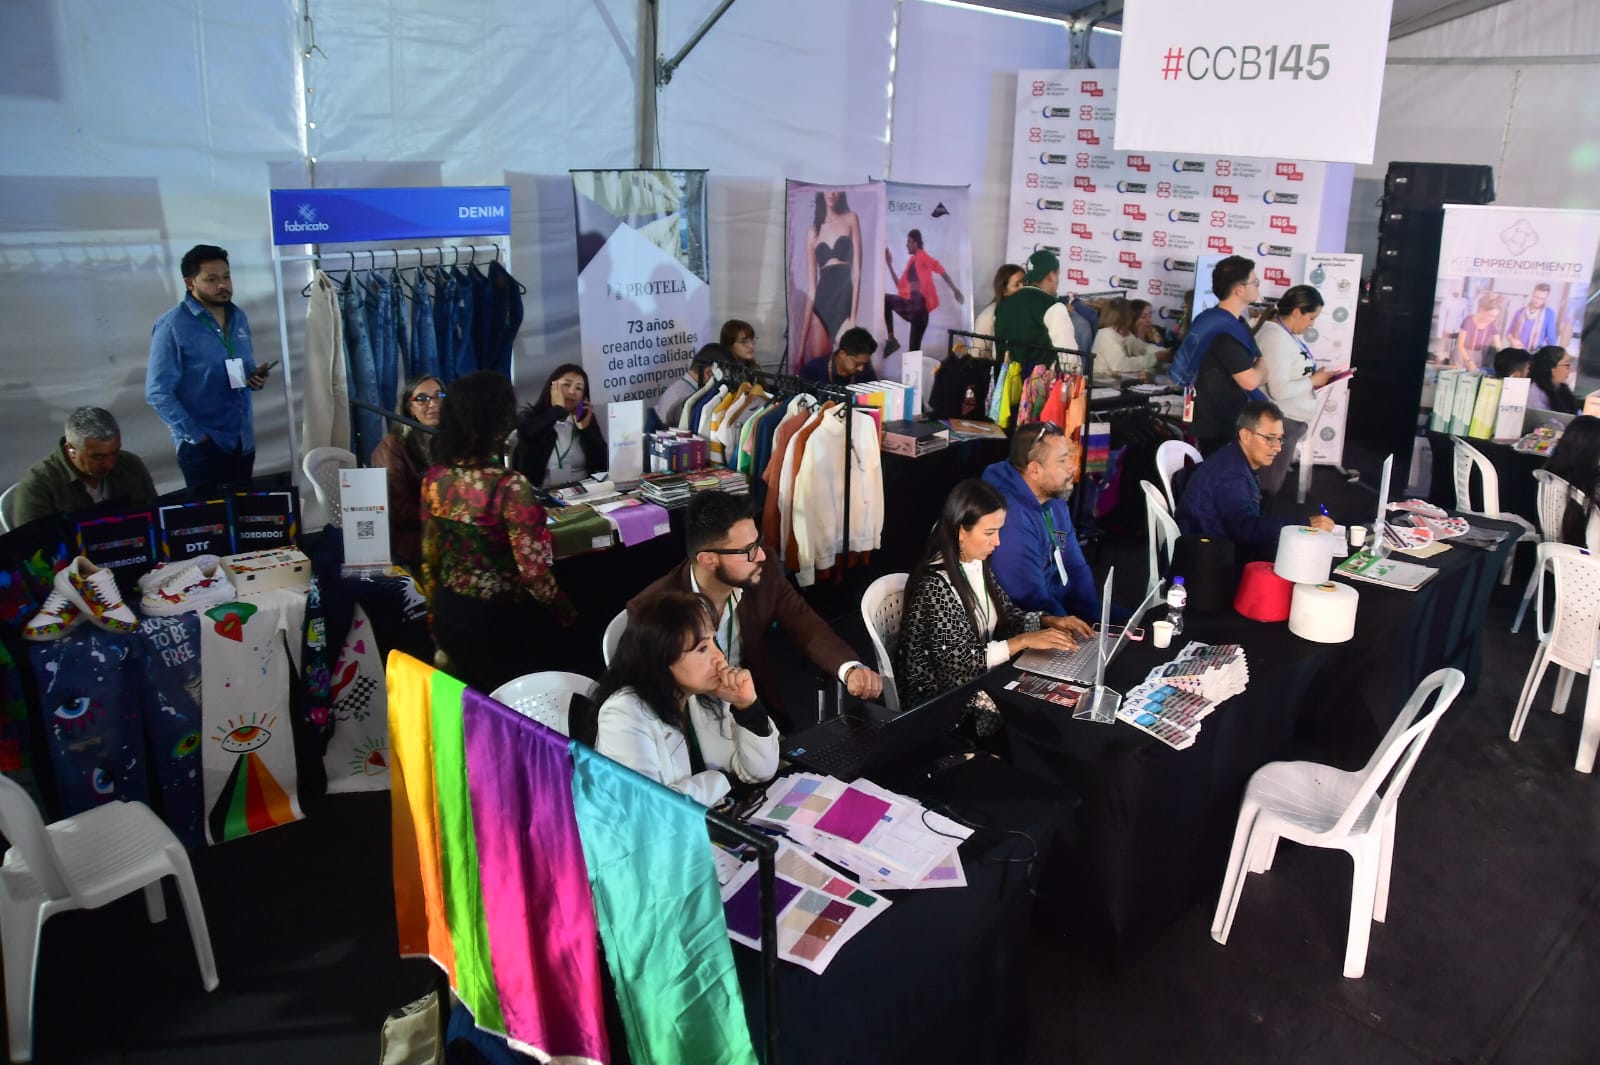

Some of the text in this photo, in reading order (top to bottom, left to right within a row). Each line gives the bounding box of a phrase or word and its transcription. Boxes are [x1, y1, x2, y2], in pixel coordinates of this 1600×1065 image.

[1162, 43, 1330, 81] #CCB145
[458, 206, 504, 219] DENIM
[284, 220, 329, 233] fabricato
[1472, 257, 1583, 273] EMPRENDIMIENTO
[625, 279, 688, 298] PROTELA
[627, 318, 675, 334] 73 años
[602, 331, 698, 354] creando textiles
[608, 346, 696, 371] de alta calidad
[603, 364, 688, 389] con compromi
[623, 385, 668, 402] experie
[149, 622, 190, 650] TO BE
[161, 641, 195, 667] FREE
